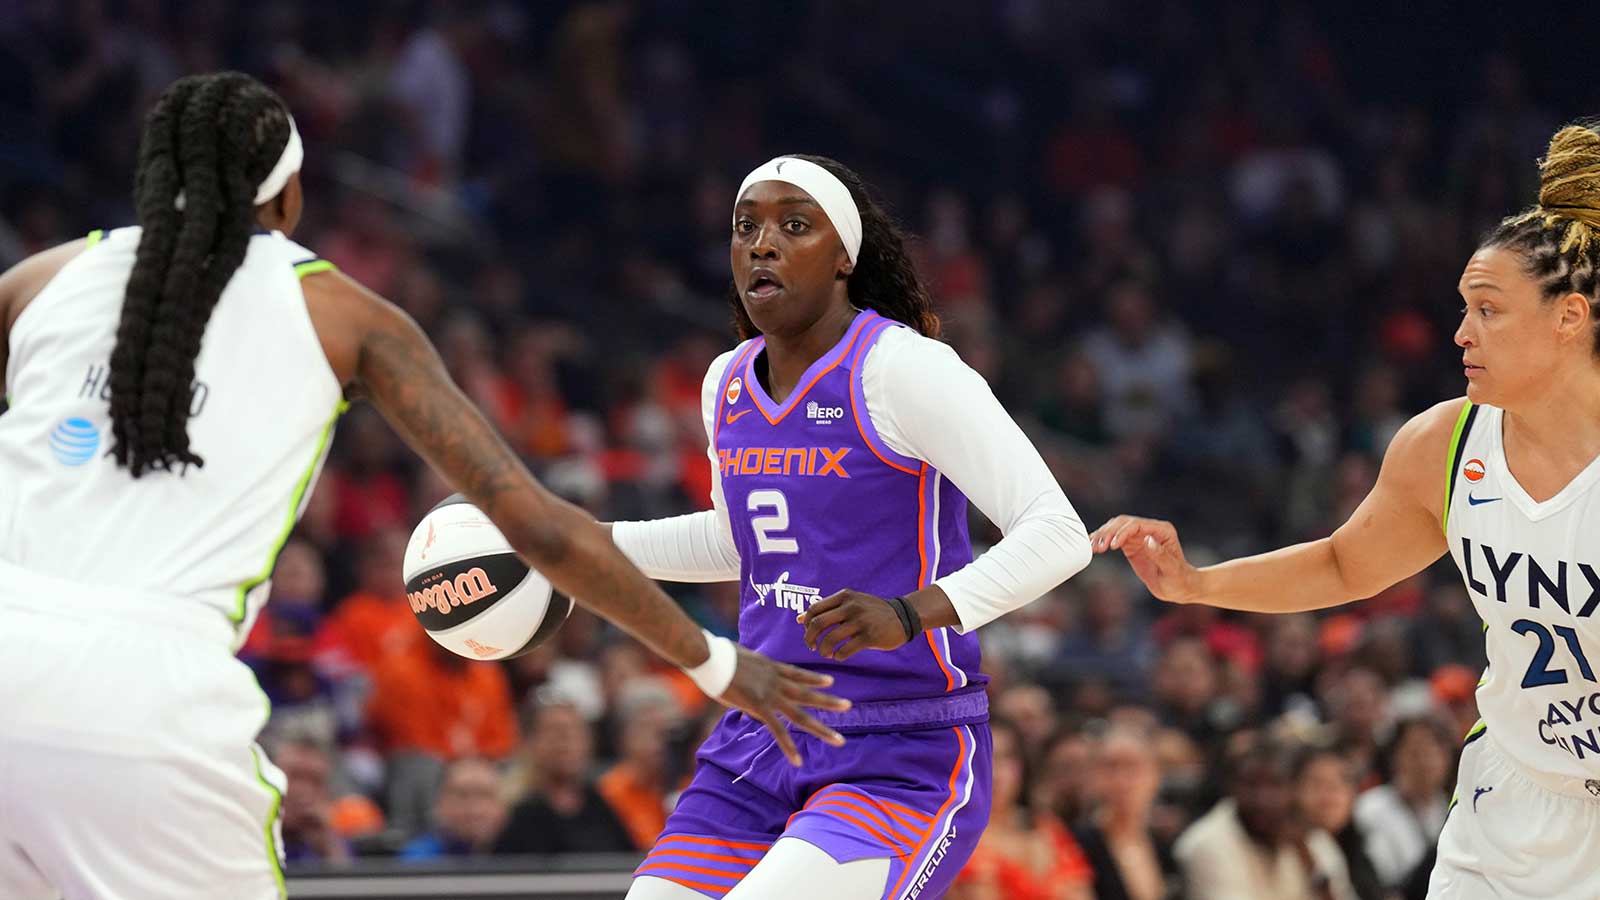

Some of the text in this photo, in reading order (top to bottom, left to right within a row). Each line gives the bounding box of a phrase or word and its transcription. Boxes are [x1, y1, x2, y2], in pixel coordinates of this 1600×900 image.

[807, 401, 844, 419] HERO
[718, 447, 853, 479] PHOENIX
[747, 488, 799, 555] 2
[408, 568, 497, 614] Wilson
[1510, 619, 1597, 689] 21
